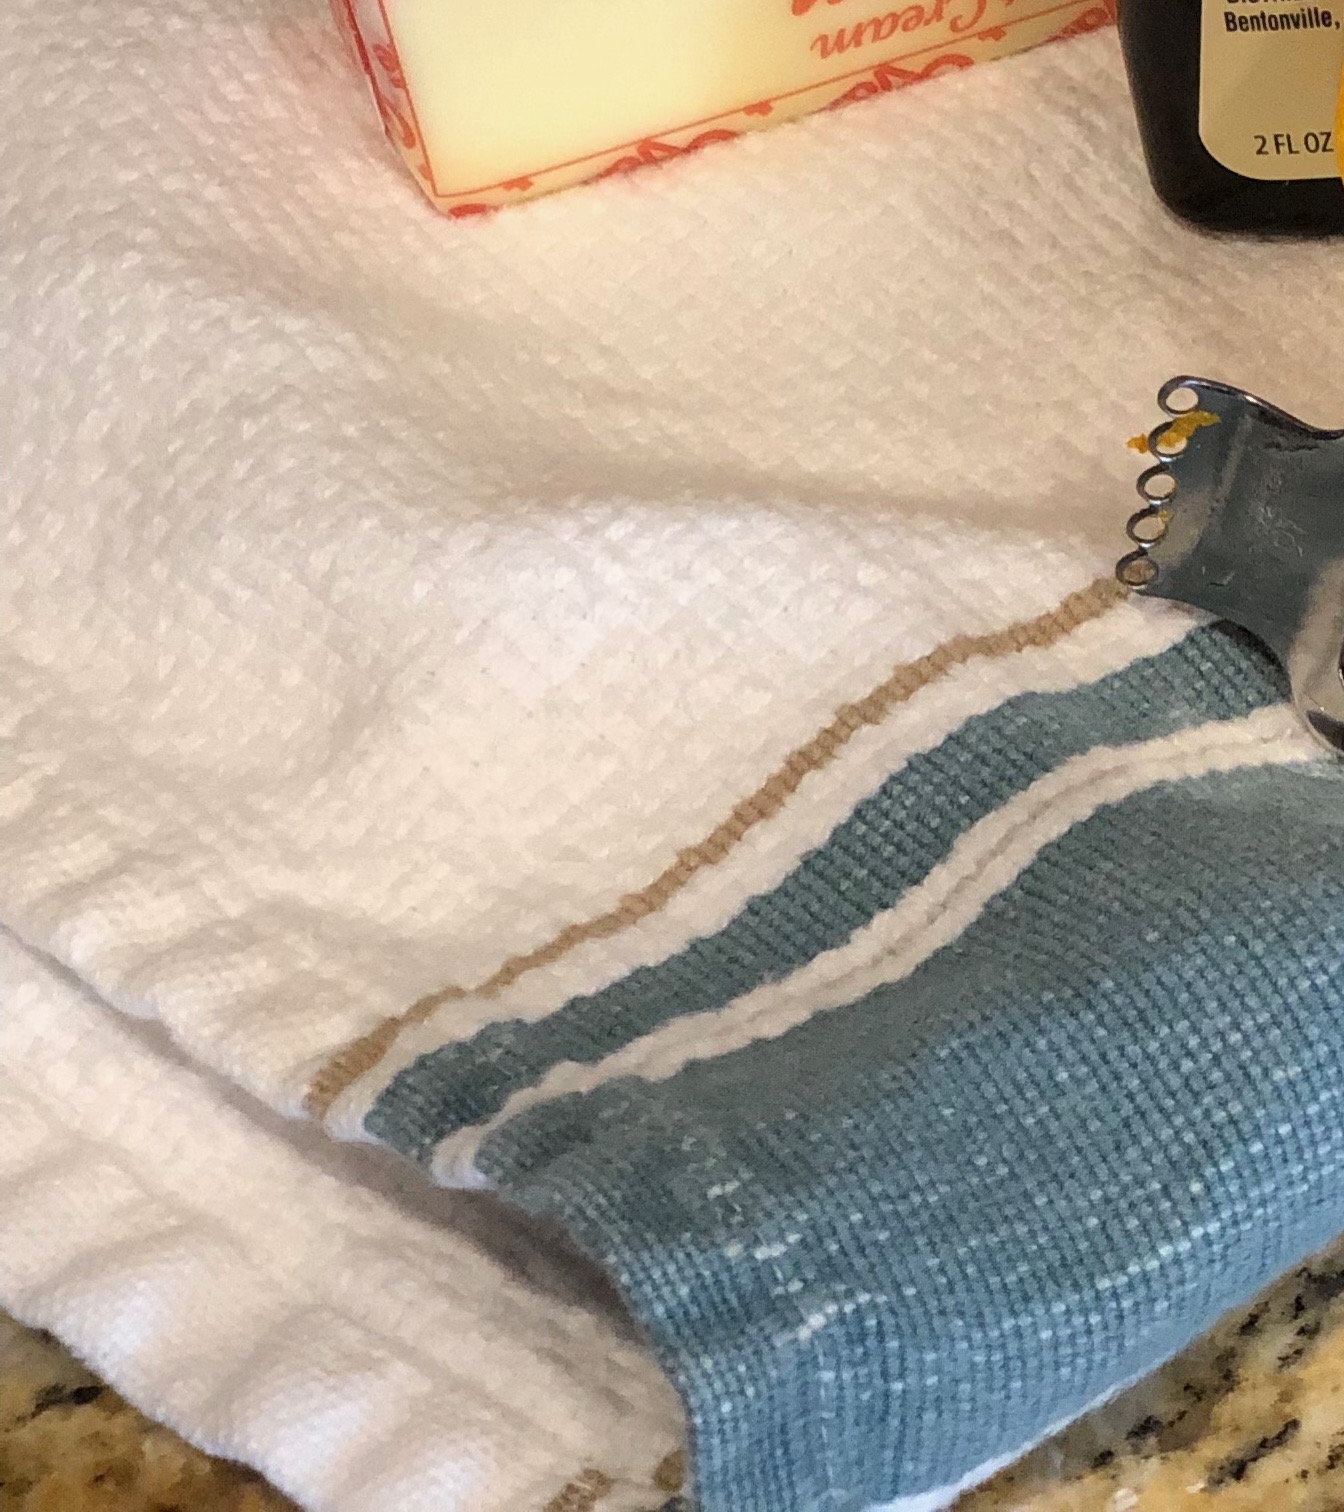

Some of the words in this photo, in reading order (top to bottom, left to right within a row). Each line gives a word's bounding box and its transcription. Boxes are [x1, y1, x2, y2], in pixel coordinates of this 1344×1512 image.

[1224, 7, 1341, 33] Bentonville,
[1254, 134, 1270, 156] 2
[1274, 134, 1300, 156] FL
[1303, 131, 1335, 154] OZ
